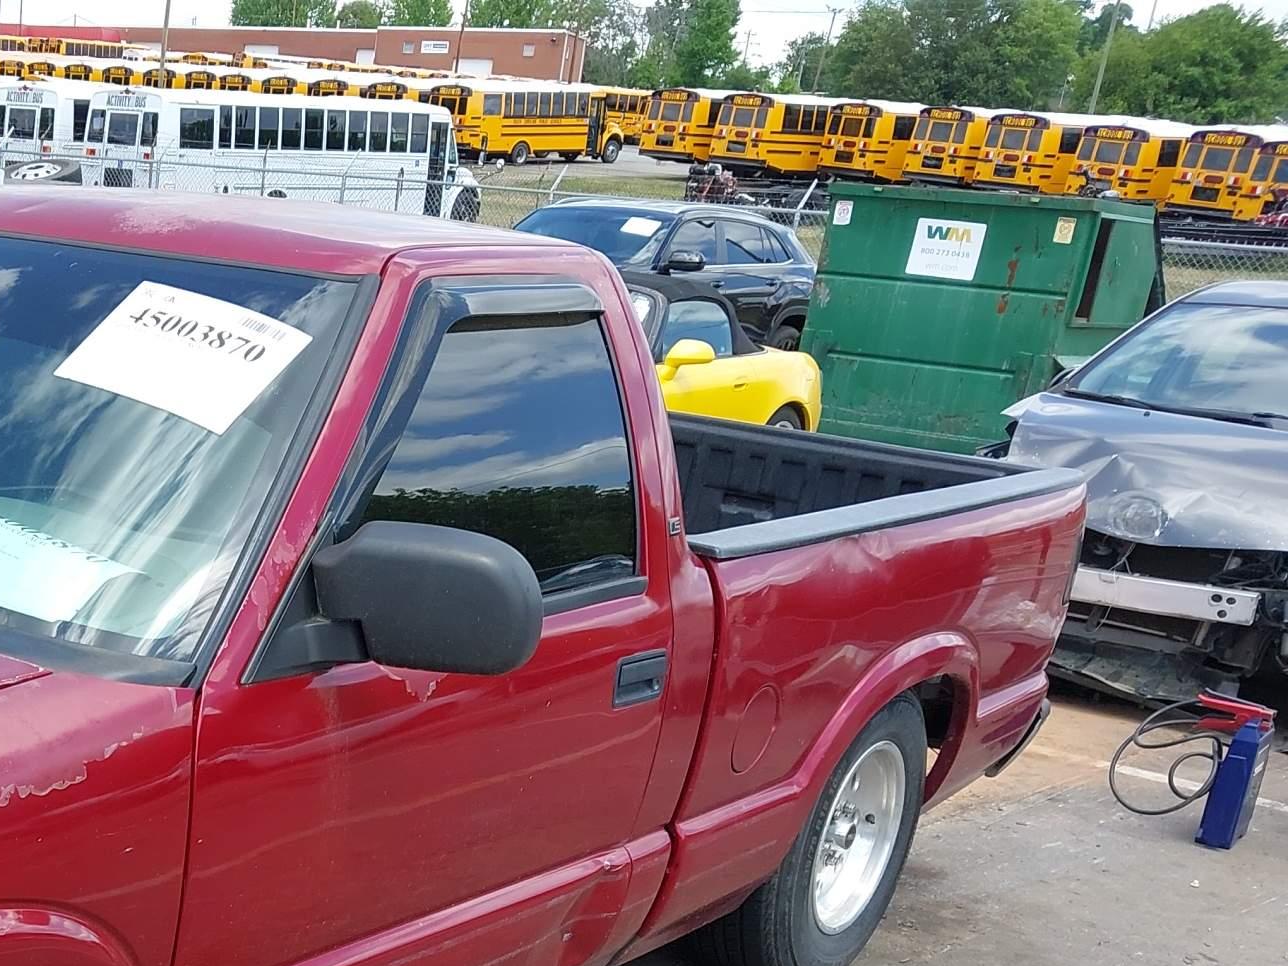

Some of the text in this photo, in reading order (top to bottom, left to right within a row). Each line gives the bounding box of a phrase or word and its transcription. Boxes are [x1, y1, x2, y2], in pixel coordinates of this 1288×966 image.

[6, 90, 43, 104] ACTIVITY BUS
[106, 95, 147, 108] ACTIVITY BUS
[927, 224, 972, 243] WM
[936, 248, 950, 257] 273
[129, 307, 266, 362] 45003870
